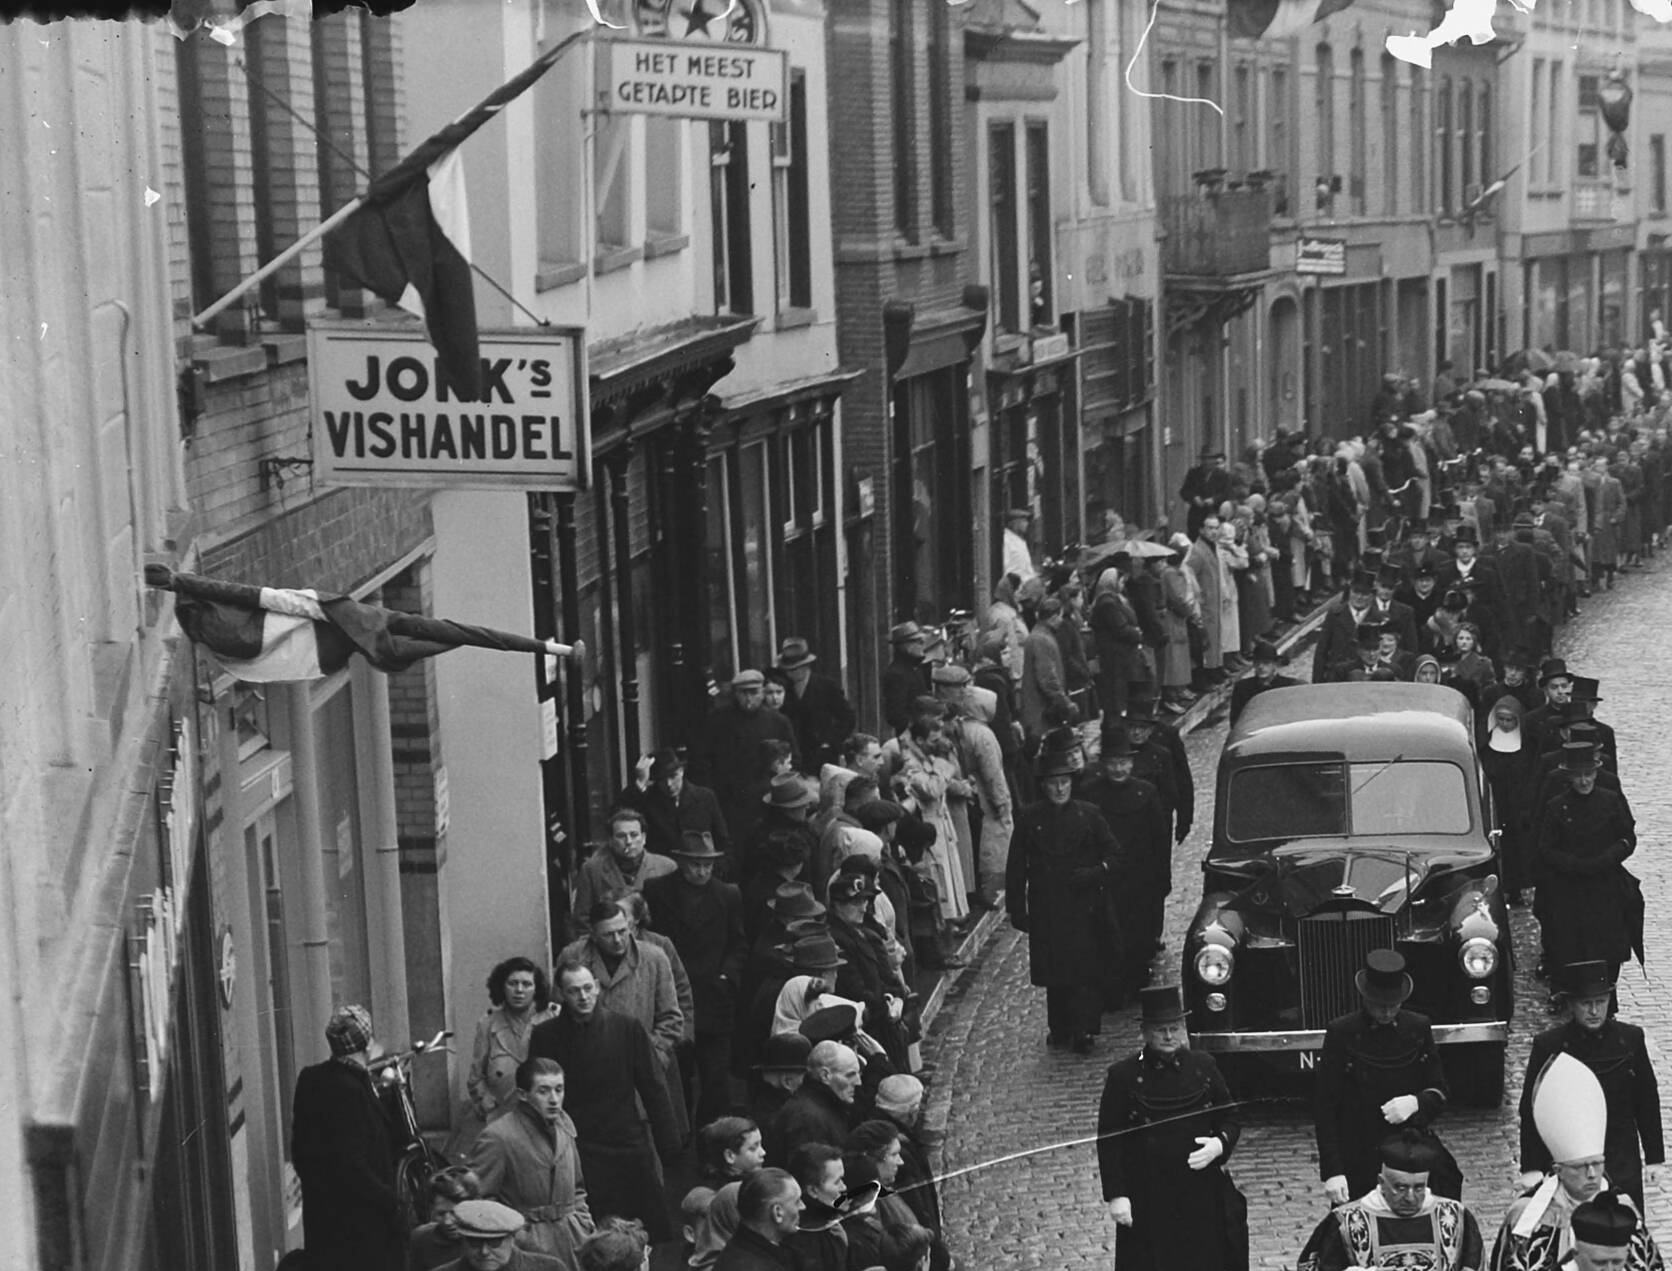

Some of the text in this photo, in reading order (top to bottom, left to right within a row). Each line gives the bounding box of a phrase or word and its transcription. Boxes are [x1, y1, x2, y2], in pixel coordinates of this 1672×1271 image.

[635, 52, 756, 80] HET MEEST
[617, 80, 778, 110] GETAPTE BIER
[323, 410, 573, 460] VISHANDEL
